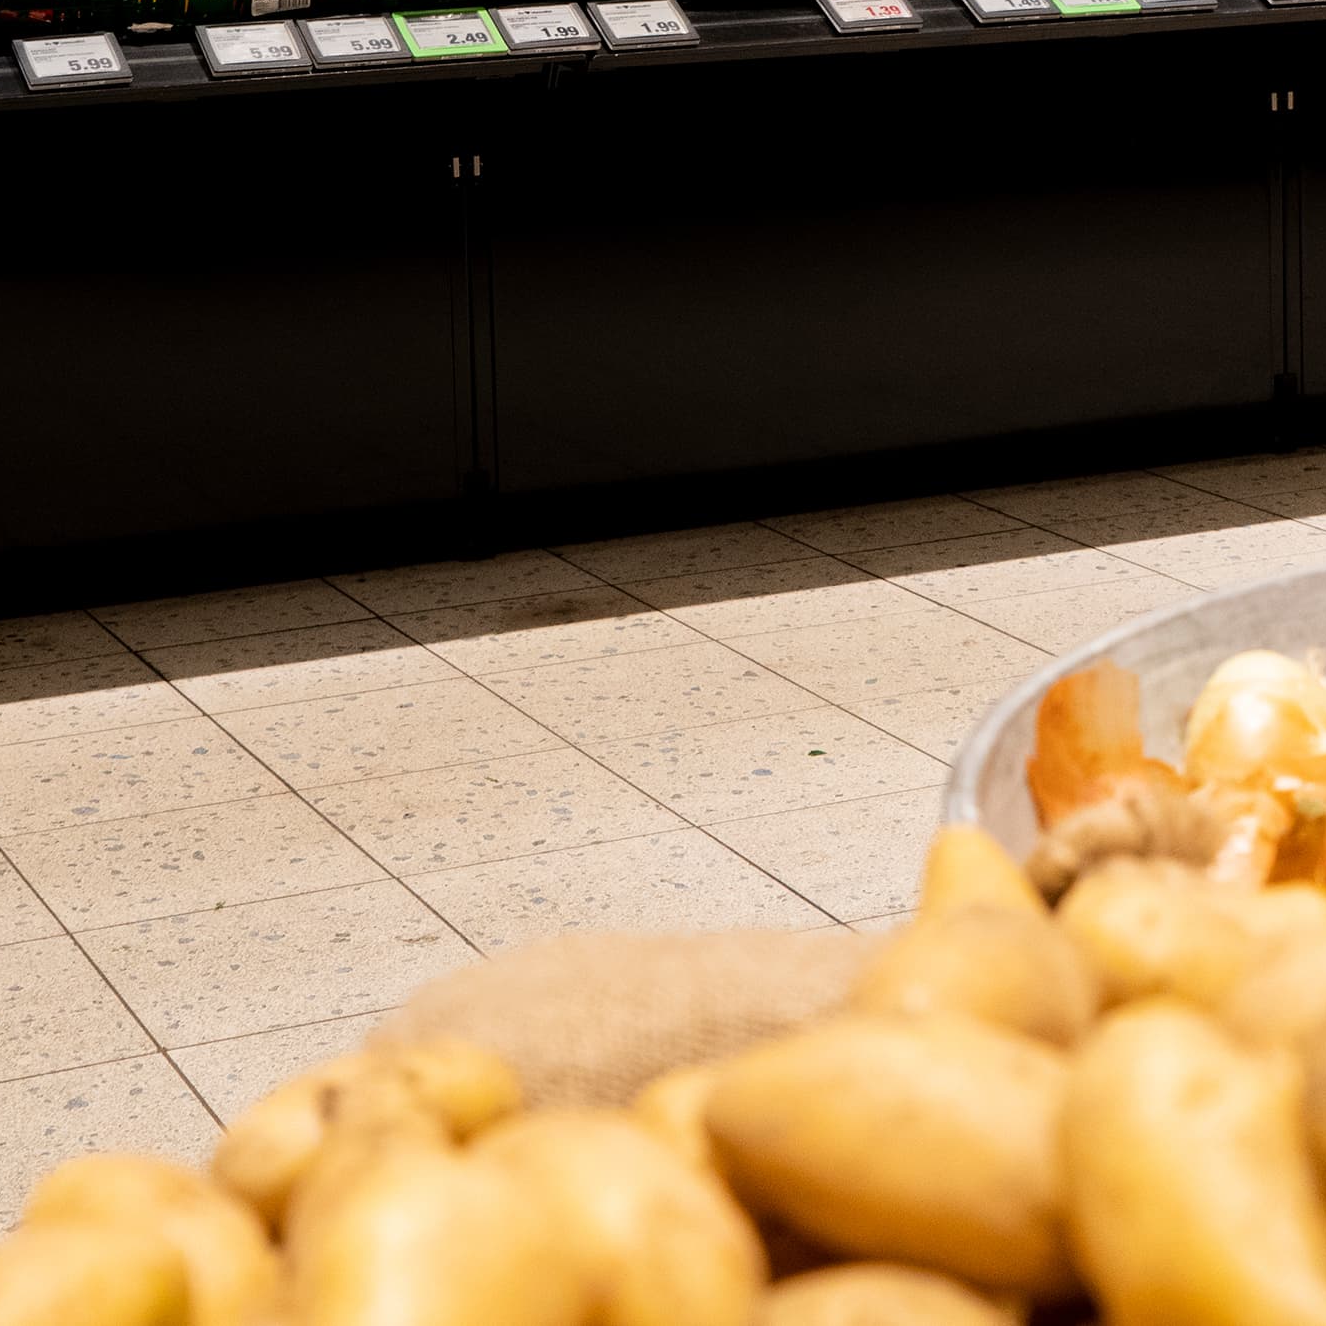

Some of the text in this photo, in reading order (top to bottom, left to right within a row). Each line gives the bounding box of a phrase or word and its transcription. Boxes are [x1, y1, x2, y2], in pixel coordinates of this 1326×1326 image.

[865, 5, 902, 17] 1.39
[540, 24, 580, 39] 1.99
[640, 19, 681, 35] 1.99
[352, 36, 393, 52] 5.99
[447, 31, 490, 46] 2.49
[249, 44, 294, 60] 5.99
[68, 56, 114, 72] 5.99
